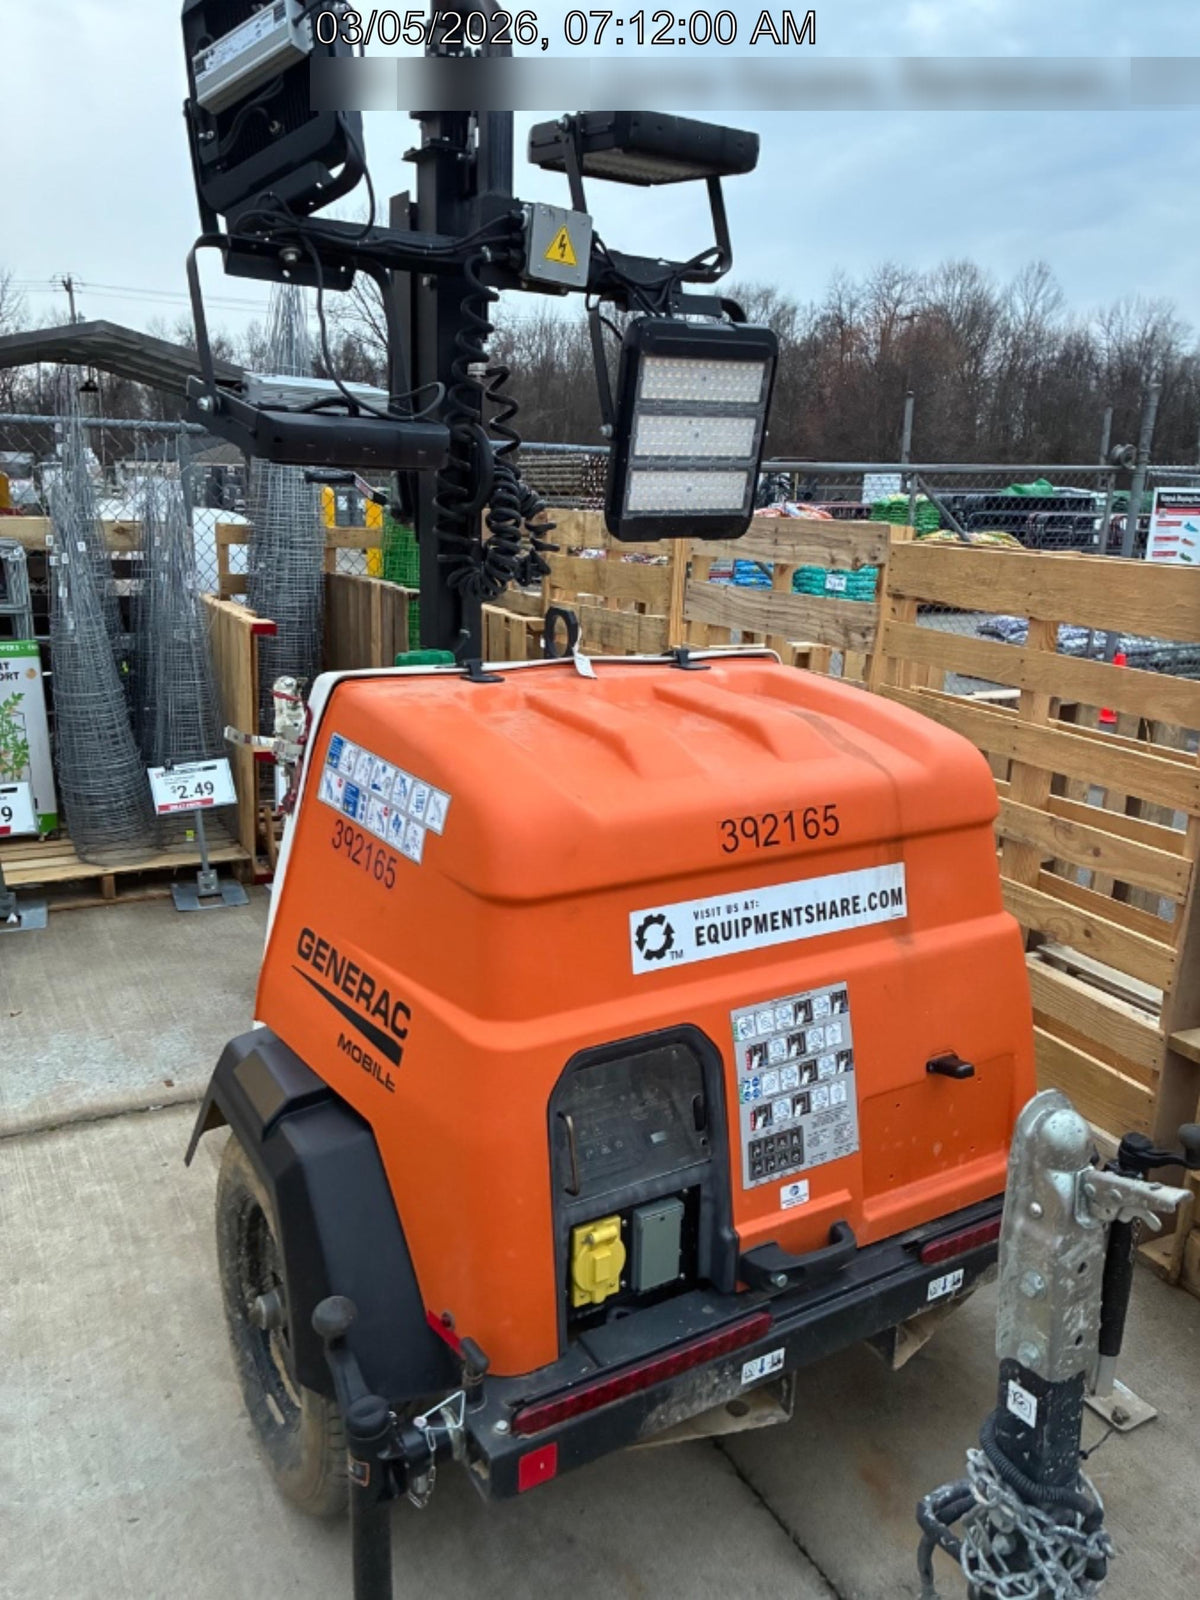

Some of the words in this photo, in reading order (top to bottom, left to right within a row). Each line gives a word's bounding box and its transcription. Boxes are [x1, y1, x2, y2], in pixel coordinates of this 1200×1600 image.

[331, 818, 398, 890] 392165
[720, 803, 840, 853] 392165
[692, 905, 722, 920] VISIT
[726, 903, 740, 914] US
[743, 900, 760, 911] AT:
[694, 886, 903, 947] EQUIPMENTSHARE.COM
[297, 926, 412, 1041] GENERAC
